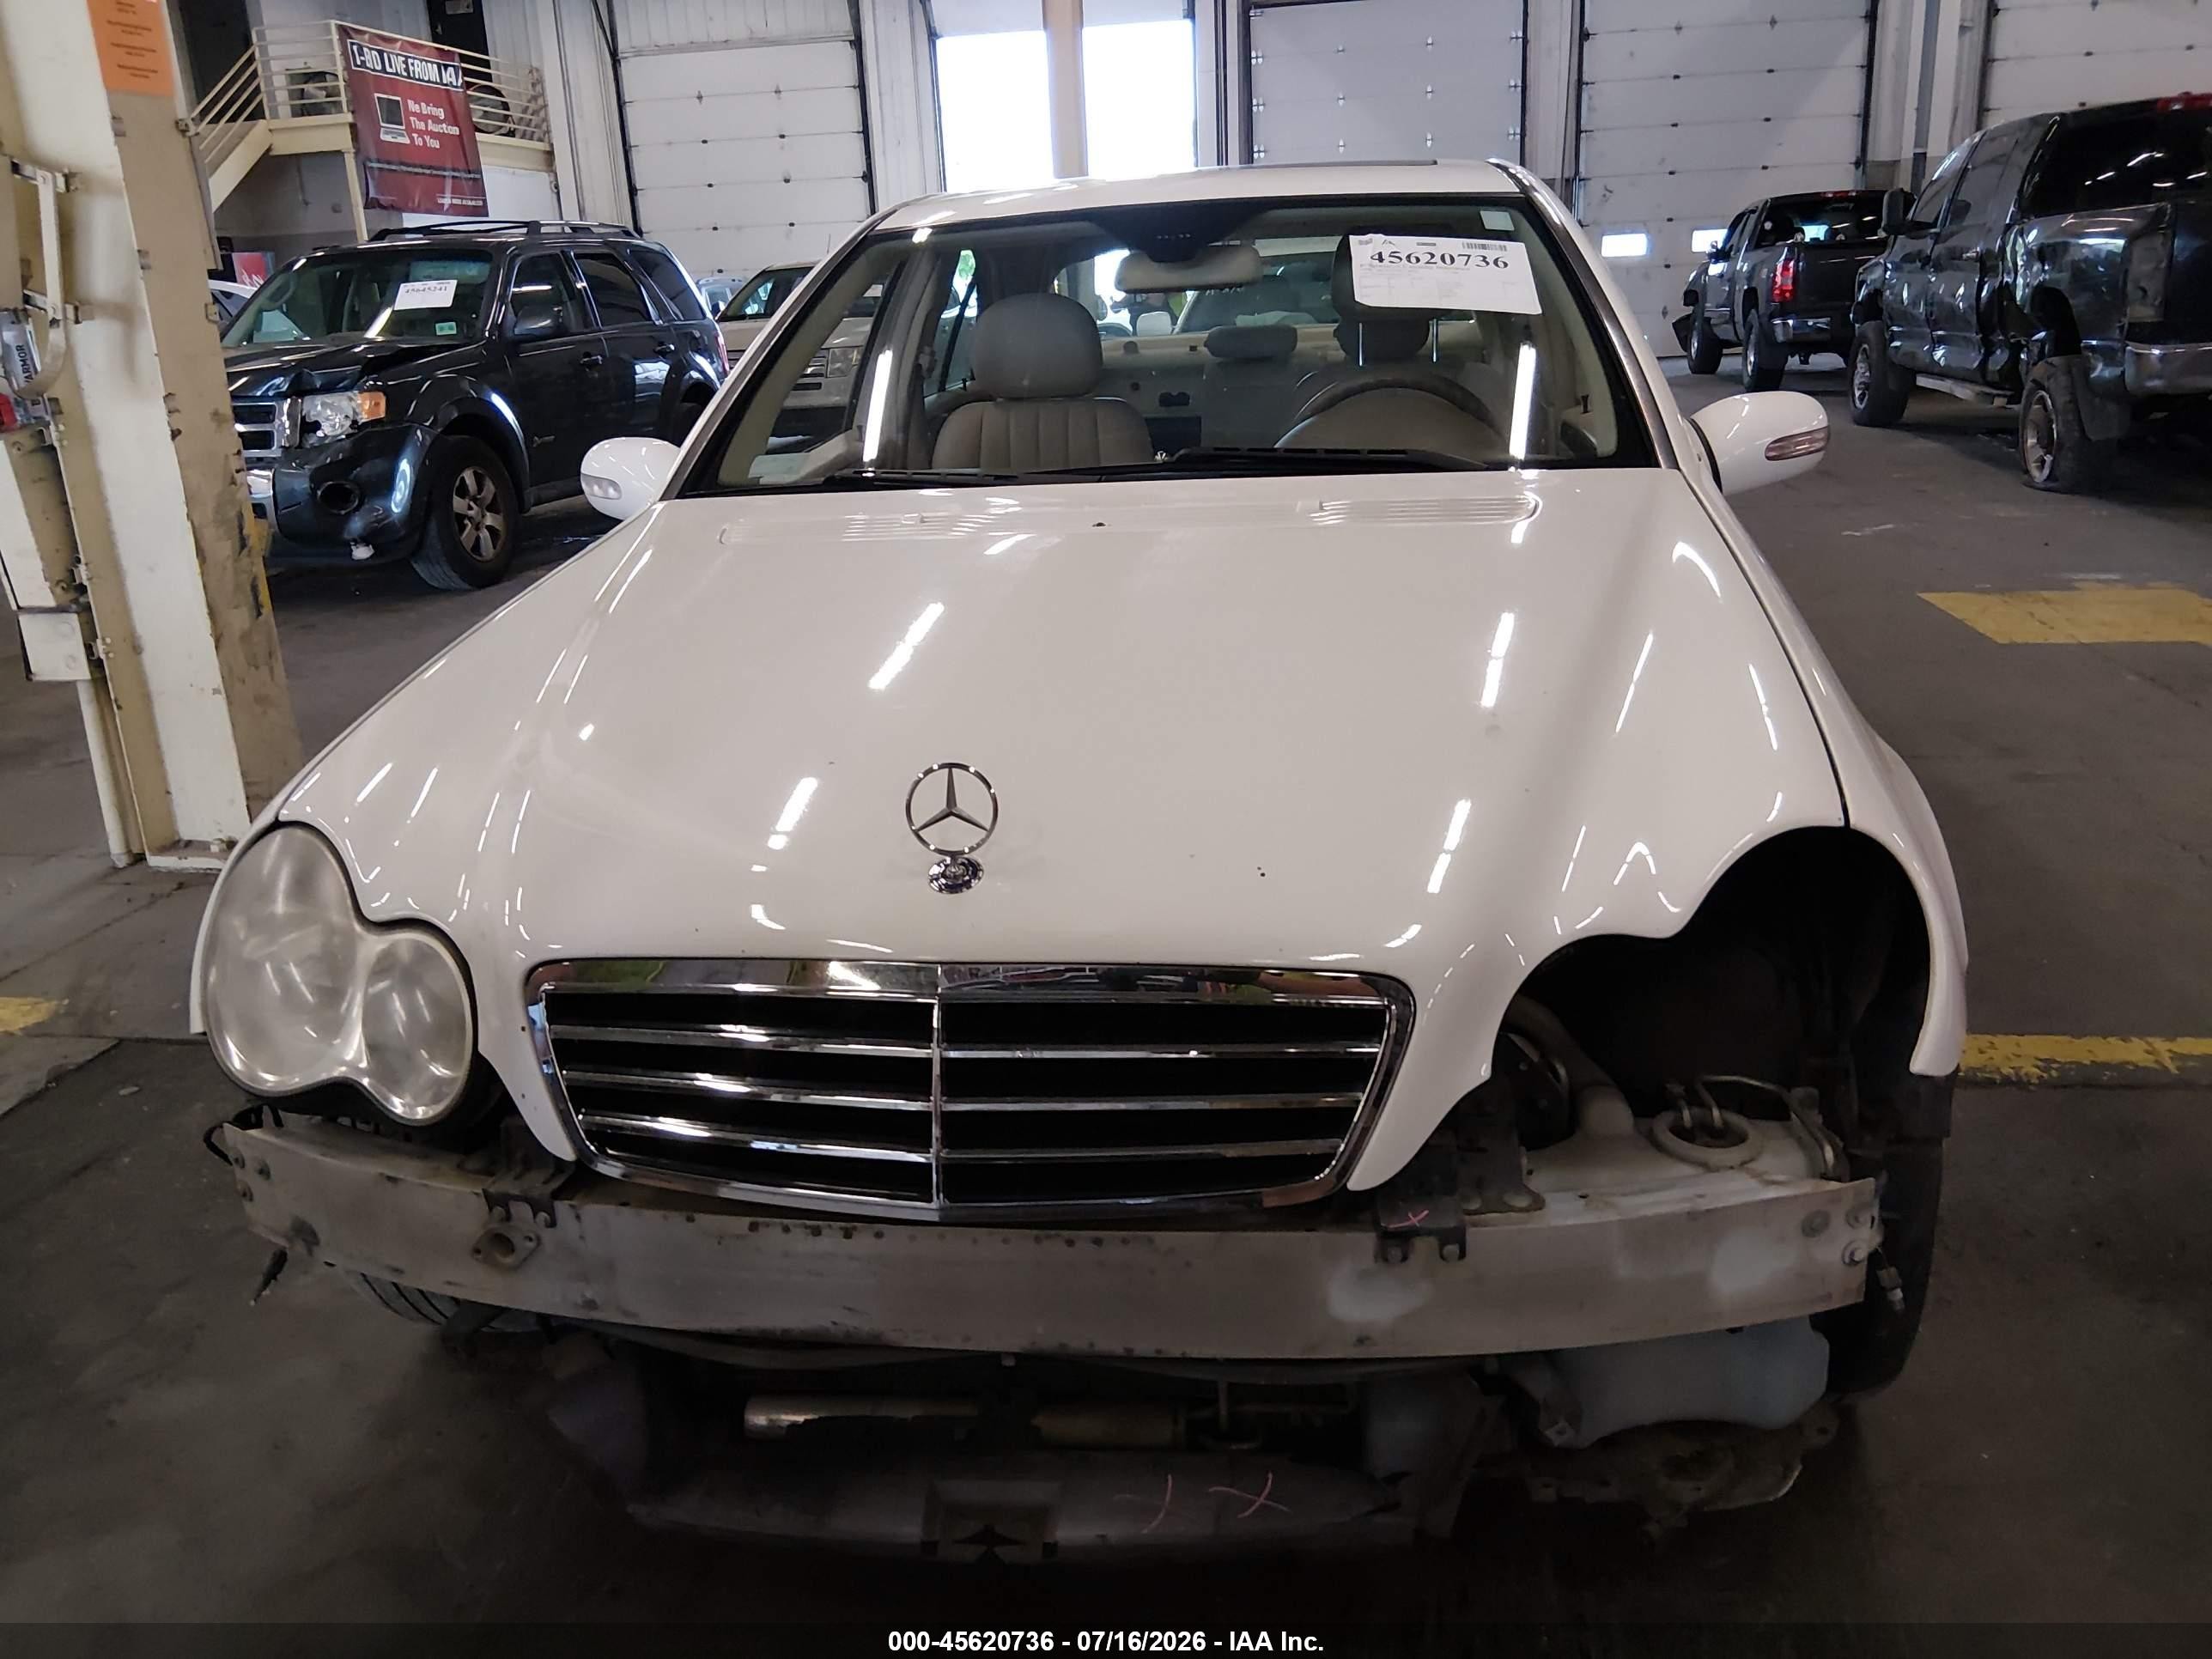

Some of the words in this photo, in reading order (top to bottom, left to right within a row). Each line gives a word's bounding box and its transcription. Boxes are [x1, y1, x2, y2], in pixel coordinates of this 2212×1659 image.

[383, 52, 408, 76] LIVE
[408, 58, 441, 83] FROM
[421, 101, 445, 119] Bring
[409, 117, 426, 131] The
[411, 133, 423, 146] To
[424, 135, 441, 149] You
[1370, 250, 1510, 270] 45620736
